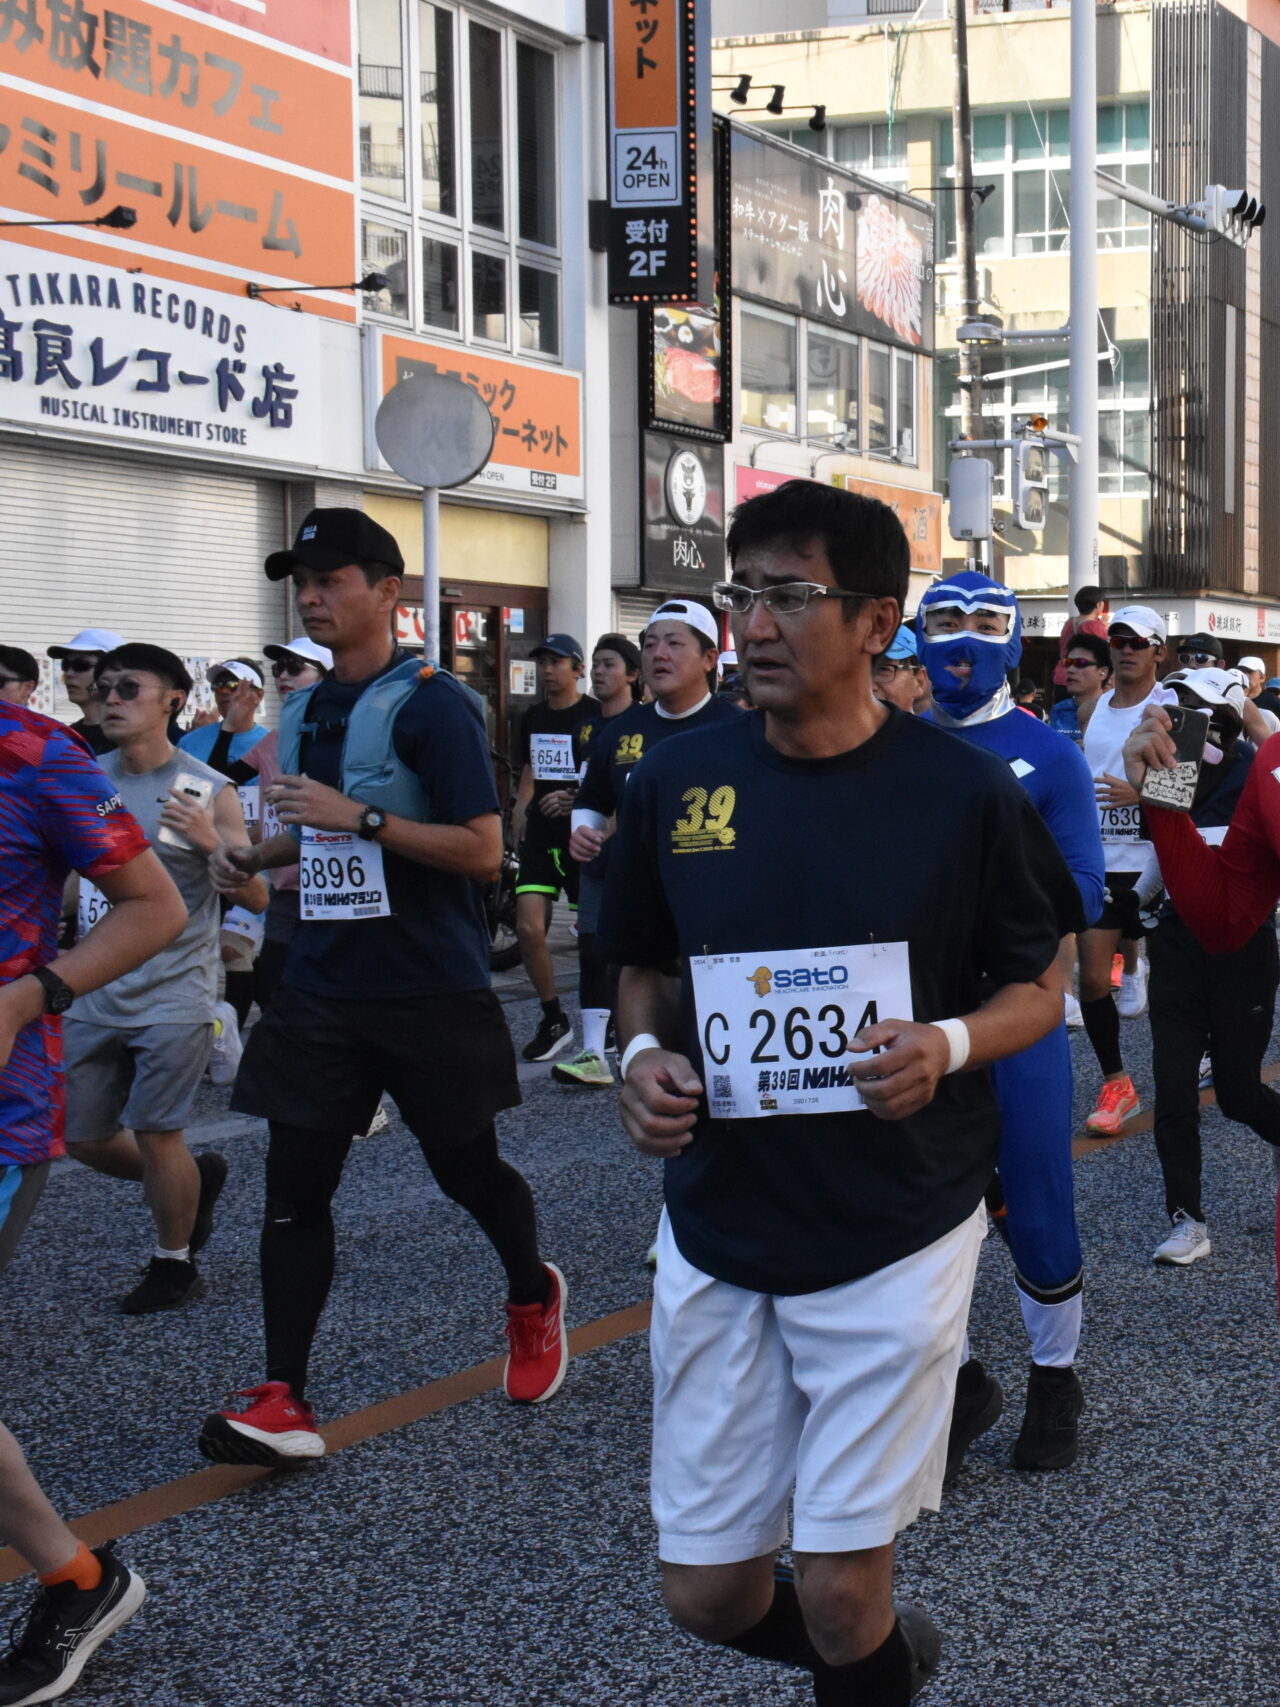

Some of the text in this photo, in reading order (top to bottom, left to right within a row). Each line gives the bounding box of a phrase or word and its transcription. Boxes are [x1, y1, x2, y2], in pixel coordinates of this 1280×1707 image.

[626, 146, 667, 171] 24h
[623, 173, 670, 189] OPEN
[625, 219, 669, 244] 受付
[629, 250, 666, 277] 2F
[6, 273, 247, 353] TAKARA RECORDS
[40, 395, 247, 445] MUSICAL INSTRUMENT STORE
[487, 470, 505, 482] OPEN
[673, 536, 702, 569] 肉心
[1216, 614, 1242, 633] 琉球銀行
[617, 733, 644, 755] 39
[538, 749, 570, 766] 6541
[675, 785, 736, 832] 39
[302, 855, 365, 889] 5896
[774, 965, 849, 988] sato
[774, 984, 849, 995] HEALTHCARE INNOVATION
[704, 1000, 881, 1065] C 2634
[758, 1069, 800, 1092] 第39回
